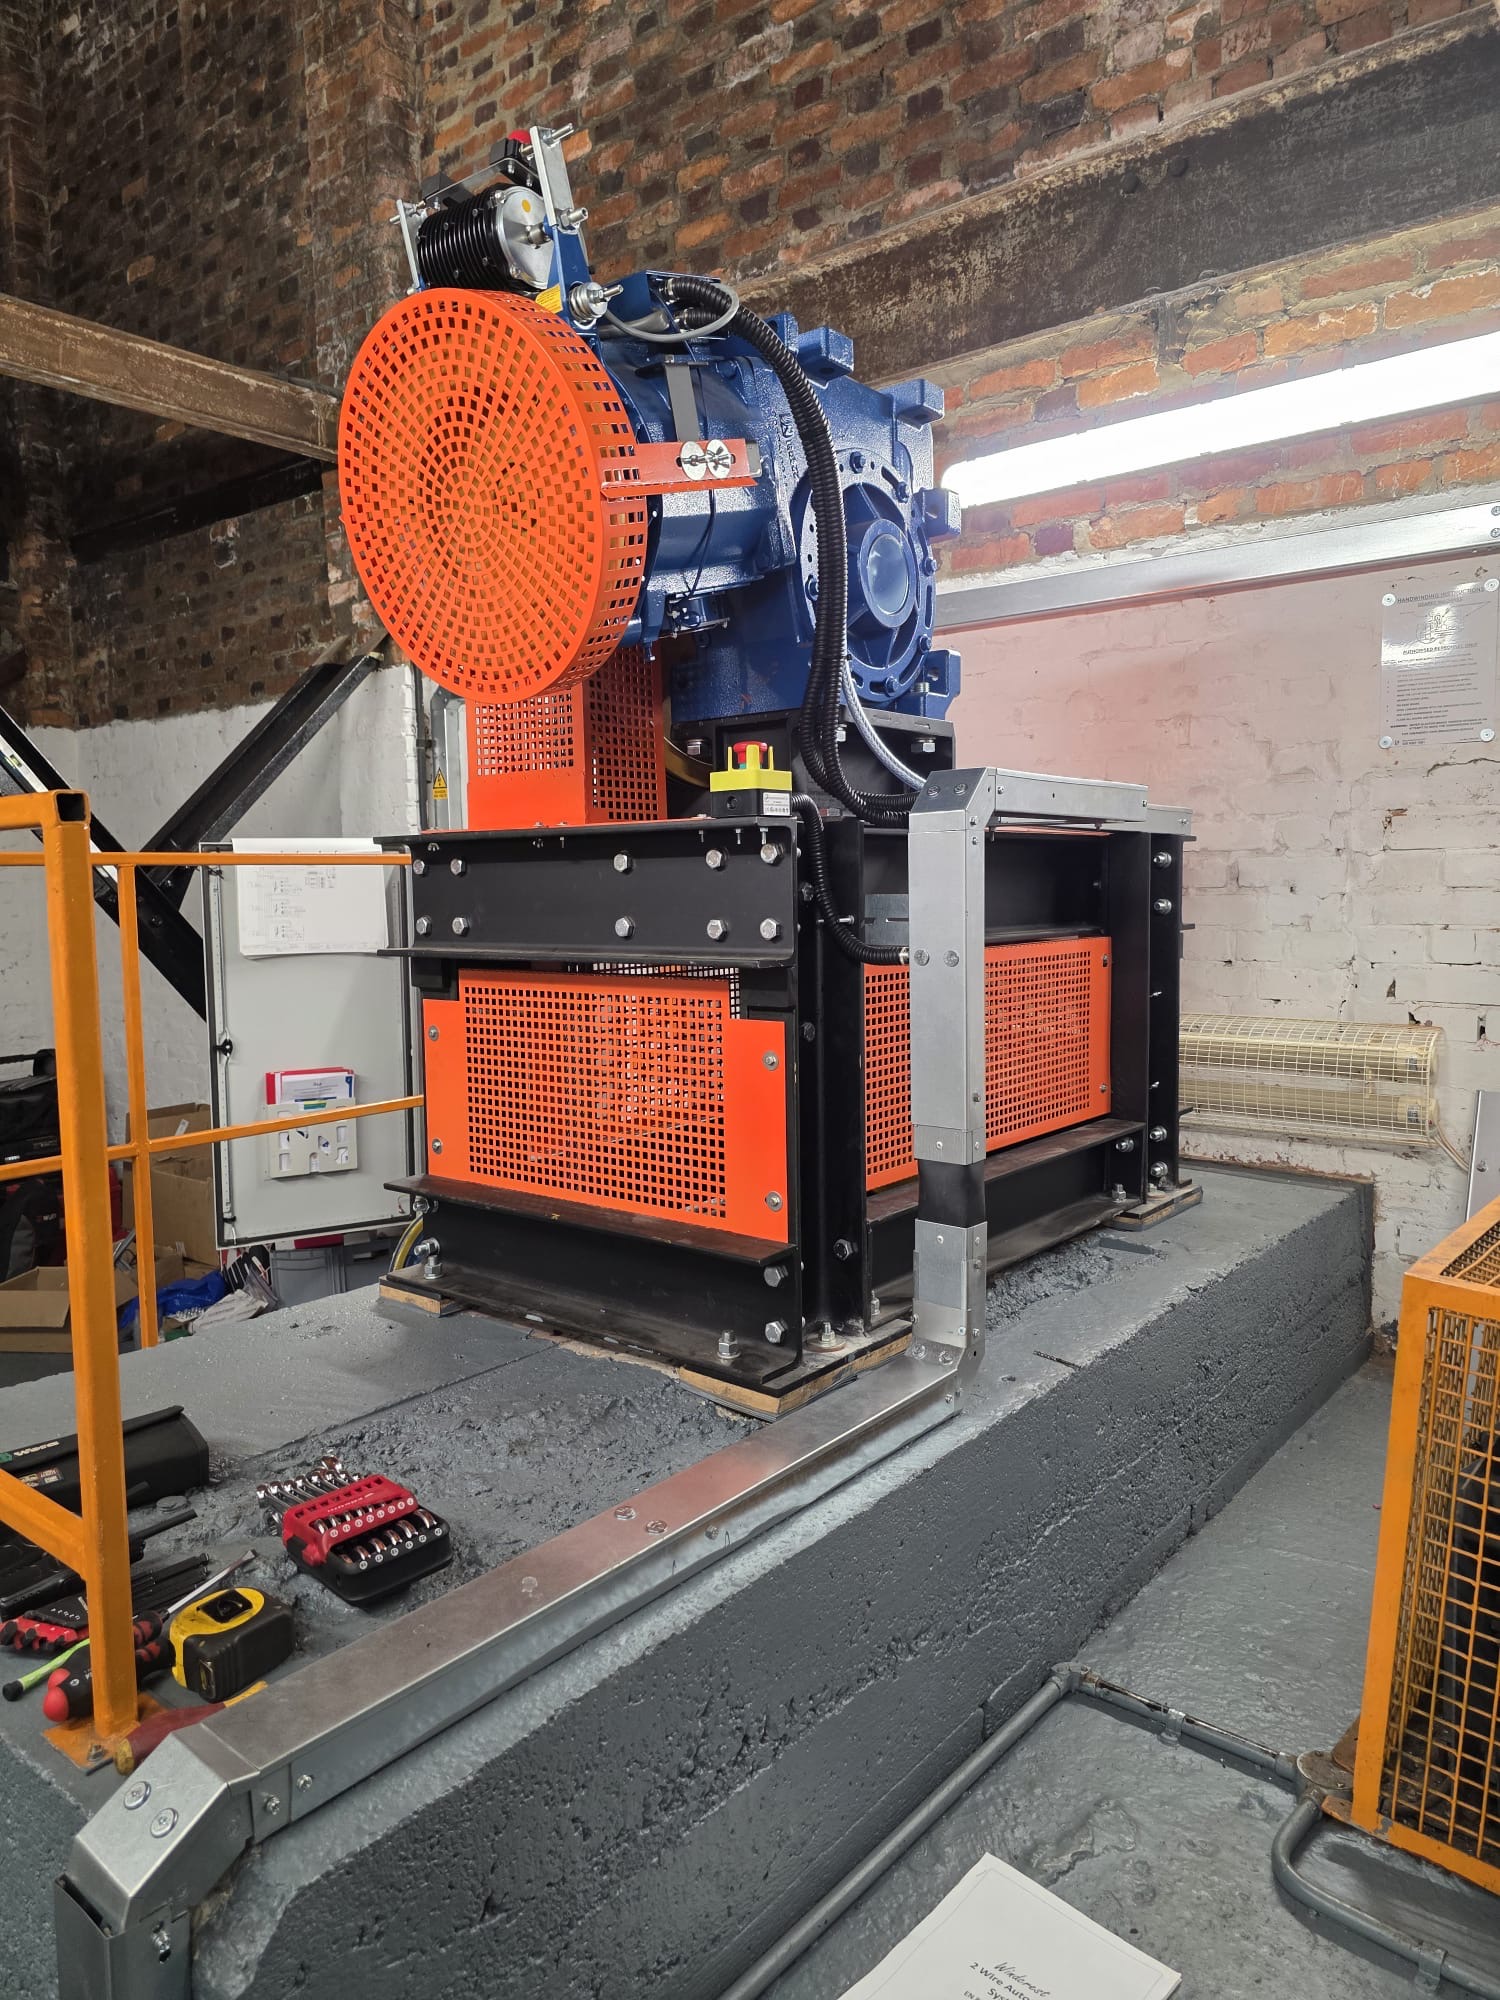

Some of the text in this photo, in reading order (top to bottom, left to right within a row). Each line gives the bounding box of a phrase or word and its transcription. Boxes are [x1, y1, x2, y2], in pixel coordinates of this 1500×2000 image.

[970, 1962, 979, 1970] 2
[980, 1967, 1003, 1985] Wire
[994, 1962, 1050, 1997] Windcrest
